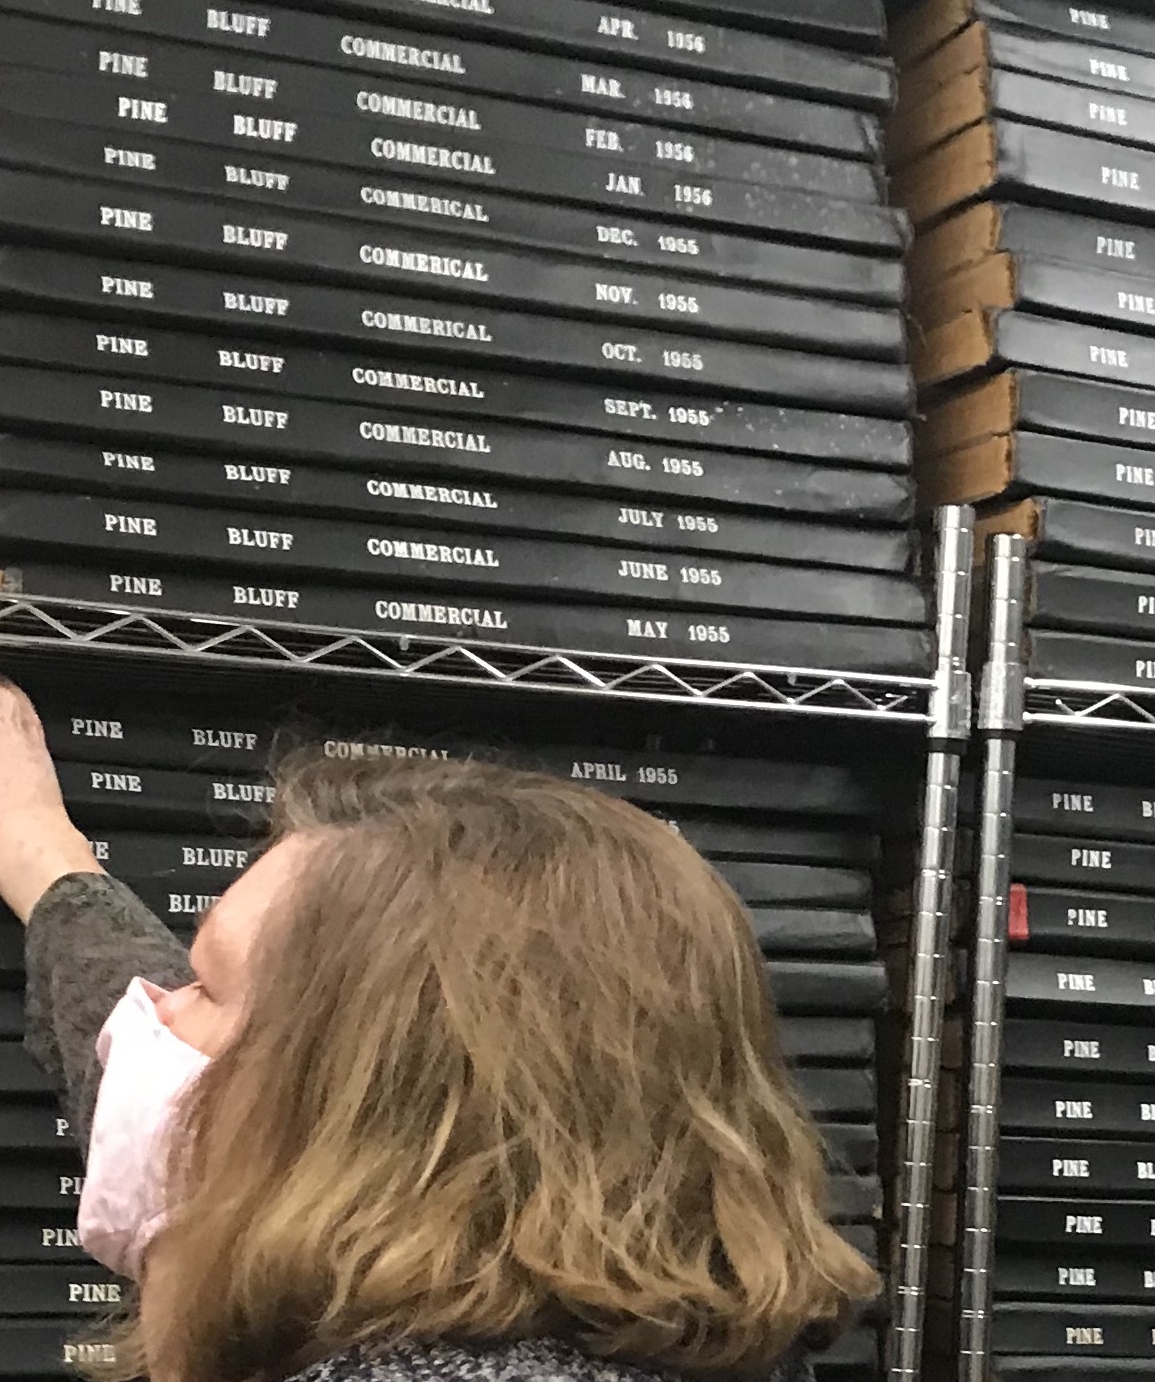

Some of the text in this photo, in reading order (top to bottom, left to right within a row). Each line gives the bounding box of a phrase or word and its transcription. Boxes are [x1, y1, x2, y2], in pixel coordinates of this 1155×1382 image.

[1069, 7, 1111, 30] PINE
[597, 16, 705, 53] APR. 1956
[206, 9, 270, 38] BLUFF
[340, 35, 466, 74] COMMERCIAL
[581, 74, 626, 99] MAR.
[1088, 58, 1131, 82] PINE
[98, 51, 148, 78] PINE
[213, 70, 277, 99] BLUFF
[356, 90, 481, 131] COMMERCIAL
[585, 128, 623, 152] FEB.
[1088, 102, 1128, 126] PINE
[118, 96, 713, 206] PINE BLUFF COMMERCIAL JAN. 1956
[1101, 166, 1141, 191] PINE
[103, 147, 700, 255] PINE BLUFF COMMERICAL DEC. 1955
[1096, 236, 1136, 260] PINE
[100, 206, 700, 314] PINE BLUFF COMMERICAL NOV. 1955
[1117, 291, 1155, 315] PINE
[101, 276, 704, 371] PINE BLUFF COMMERICAL OCT. 1955
[1089, 345, 1129, 368] PINE
[95, 334, 710, 427] PINE BLUFF COMMERCIAL SEPT. 1955
[1118, 407, 1155, 430] PINE
[99, 389, 704, 477] PINE BLUFF COMMERCIAL AUG. 1955
[1116, 463, 1155, 486] PINE
[102, 451, 719, 533] PINE BLUFF COMMERCIAL JULY 1955
[104, 513, 722, 586] PINE BLUFF COMMERCIAL JUNE 1955
[109, 574, 730, 643] PINE BLUFF COMMERCIAL MAY 1955
[71, 718, 678, 785] PINE BLUFF APRIL 1955
[90, 772, 277, 804] PINE BLUFF
[1052, 793, 1094, 812] PINE
[181, 846, 249, 868] BLUFF
[1071, 848, 1112, 869] PINE
[168, 894, 218, 913] BLU
[1067, 908, 1108, 928] PINE
[1057, 973, 1096, 992] PINE
[1063, 1039, 1101, 1059] PINE
[1055, 1100, 1093, 1119] PINE
[1052, 1159, 1090, 1178] PINE
[59, 1176, 83, 1195] PI
[1065, 1215, 1103, 1234] PINE
[42, 1228, 81, 1247] PIN
[1057, 1267, 1097, 1287] PINE
[68, 1283, 121, 1302] PINE
[1065, 1327, 1104, 1345] PINE
[63, 1343, 116, 1363] PINE
